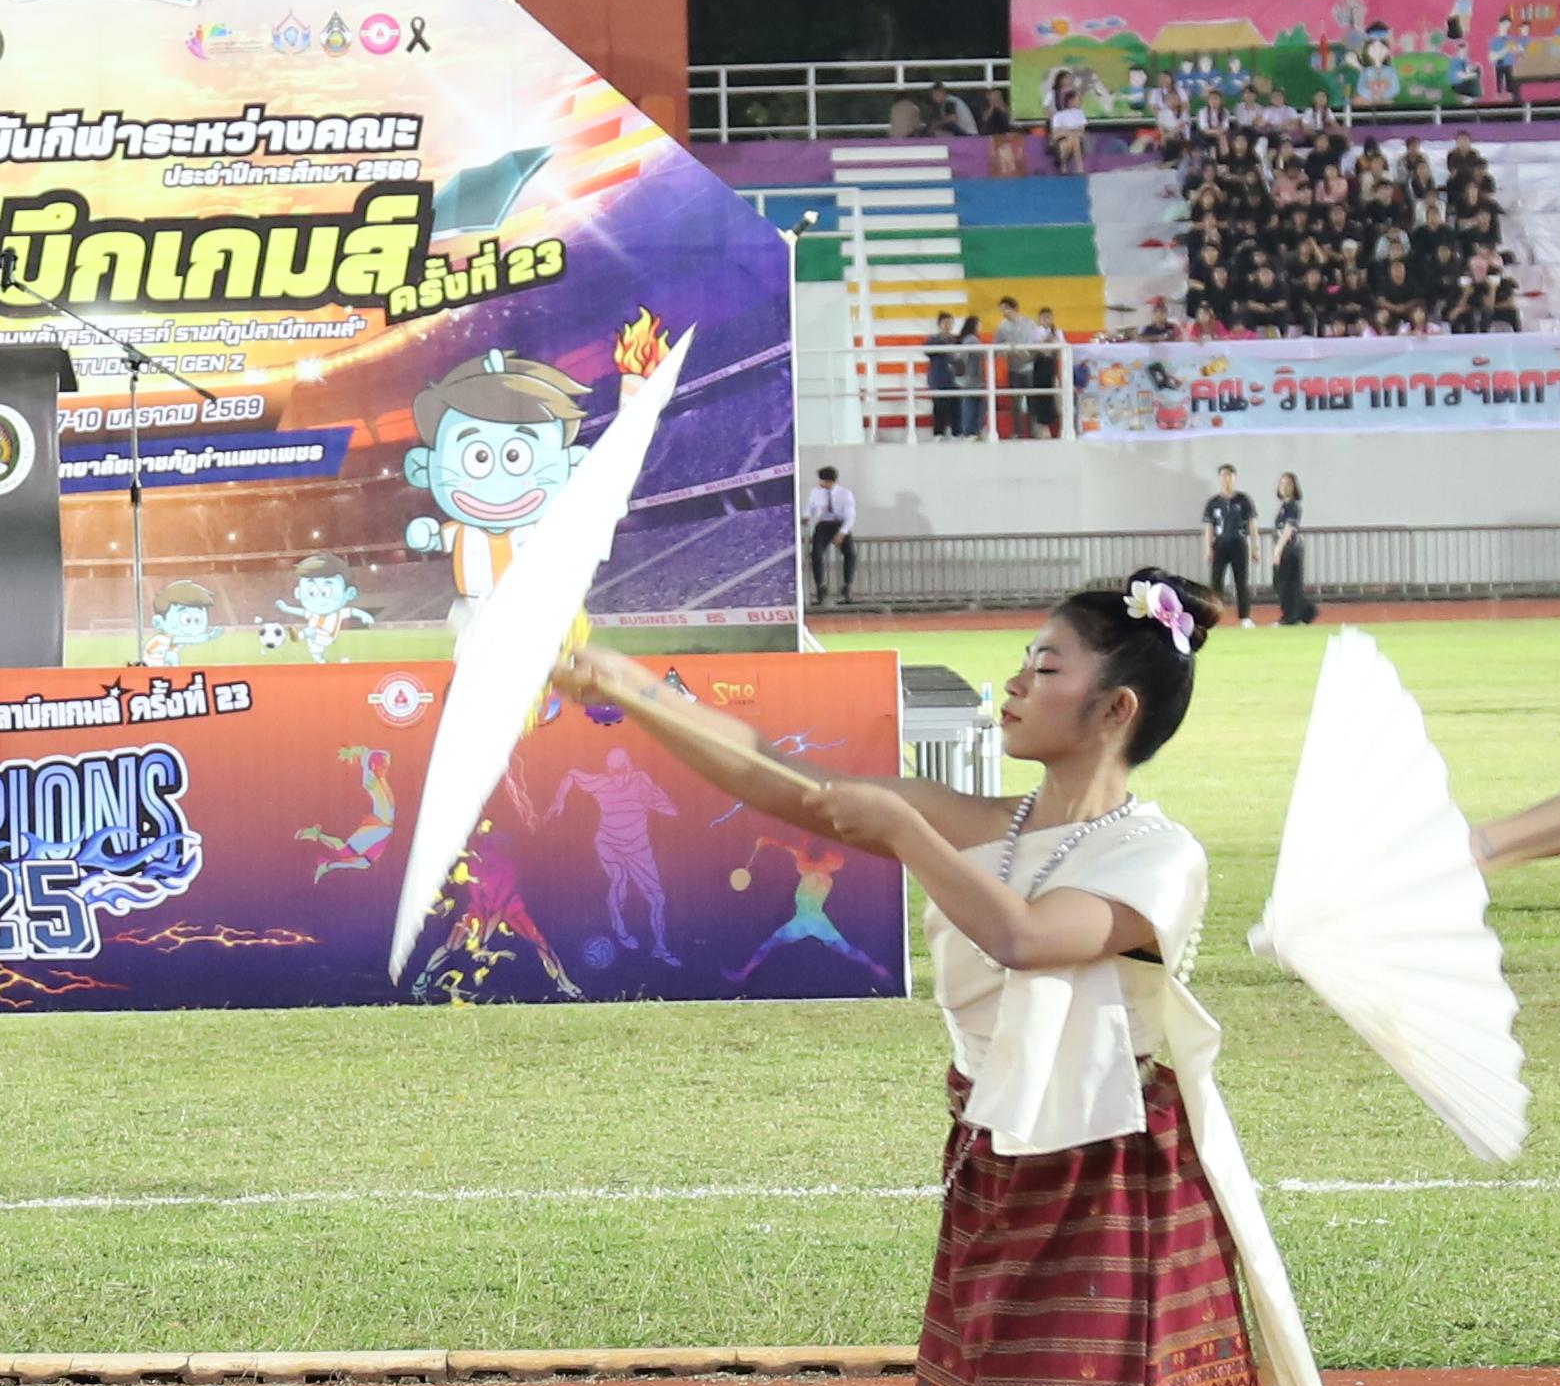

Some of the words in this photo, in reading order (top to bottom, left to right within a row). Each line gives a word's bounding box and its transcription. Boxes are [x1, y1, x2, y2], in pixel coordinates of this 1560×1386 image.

[164, 159, 353, 187] ประจำปีการศึกษา
[388, 240, 499, 317] ครั้งที่
[506, 238, 565, 285] 23
[180, 355, 224, 374] GEN
[228, 354, 246, 372] Z
[1190, 376, 1265, 412] คณะ
[201, 397, 264, 422] 2569
[619, 613, 688, 625] BUSINESS
[129, 675, 208, 722] ครั้งที่
[213, 683, 251, 712] 23
[712, 681, 755, 705] SMO
